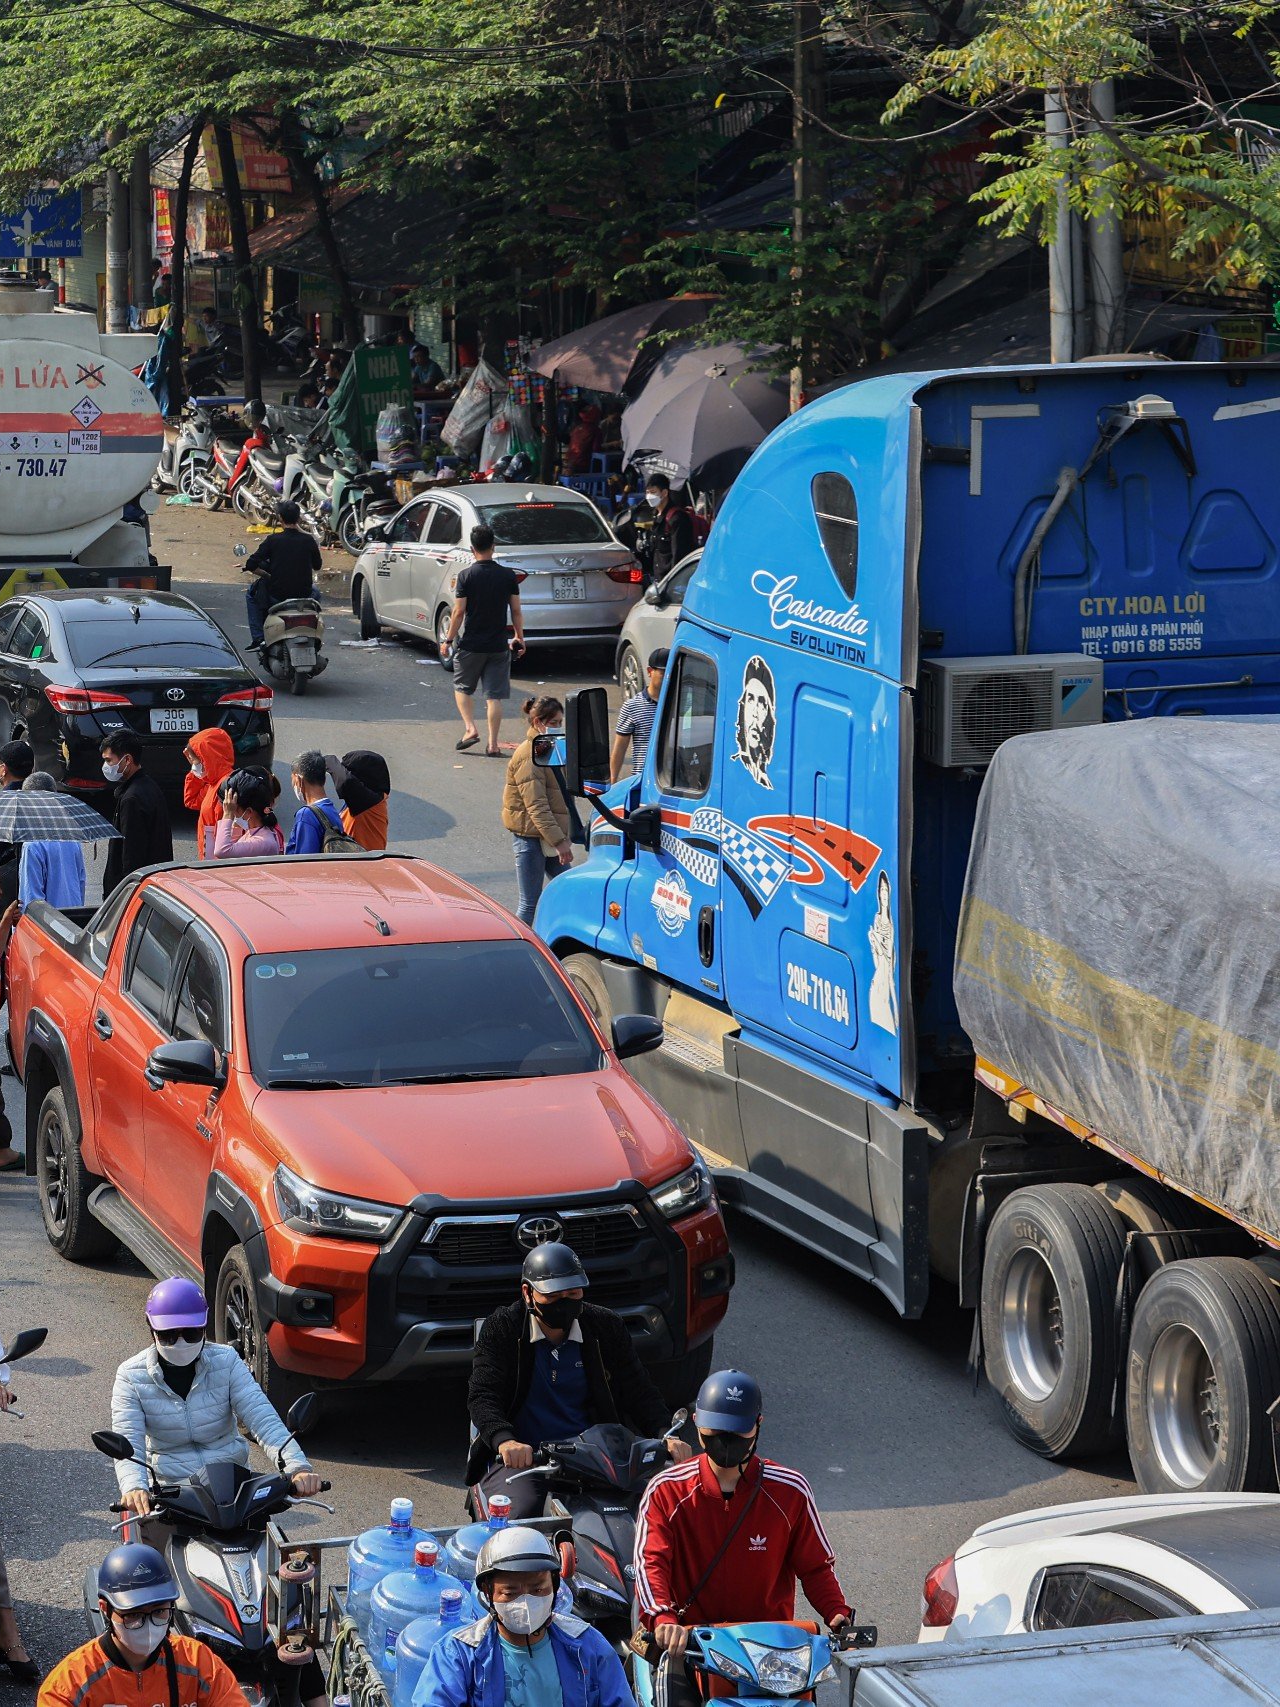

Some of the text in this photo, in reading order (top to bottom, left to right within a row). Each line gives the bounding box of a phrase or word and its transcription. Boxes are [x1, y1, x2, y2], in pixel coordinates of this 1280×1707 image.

[15, 359, 68, 388] LỬA
[84, 416, 89, 424] 3
[71, 438, 80, 446] UN
[16, 458, 67, 477] 730.47
[561, 577, 577, 588] 30E
[751, 570, 868, 640] Cascadia
[1080, 591, 1205, 618] CTY.HOA LỢI
[1141, 624, 1149, 636] &
[1152, 622, 1178, 635] PHÂN
[1180, 619, 1203, 634] PHỐI
[790, 630, 866, 664] EVOLUTION
[1112, 640, 1145, 654] 0916
[1149, 639, 1165, 652] 88
[1169, 638, 1202, 651] 5555
[164, 709, 185, 720] 30G
[156, 721, 194, 731] 700.89
[787, 962, 849, 1026] 29H-718.64
[1015, 1222, 1038, 1242] Giti
